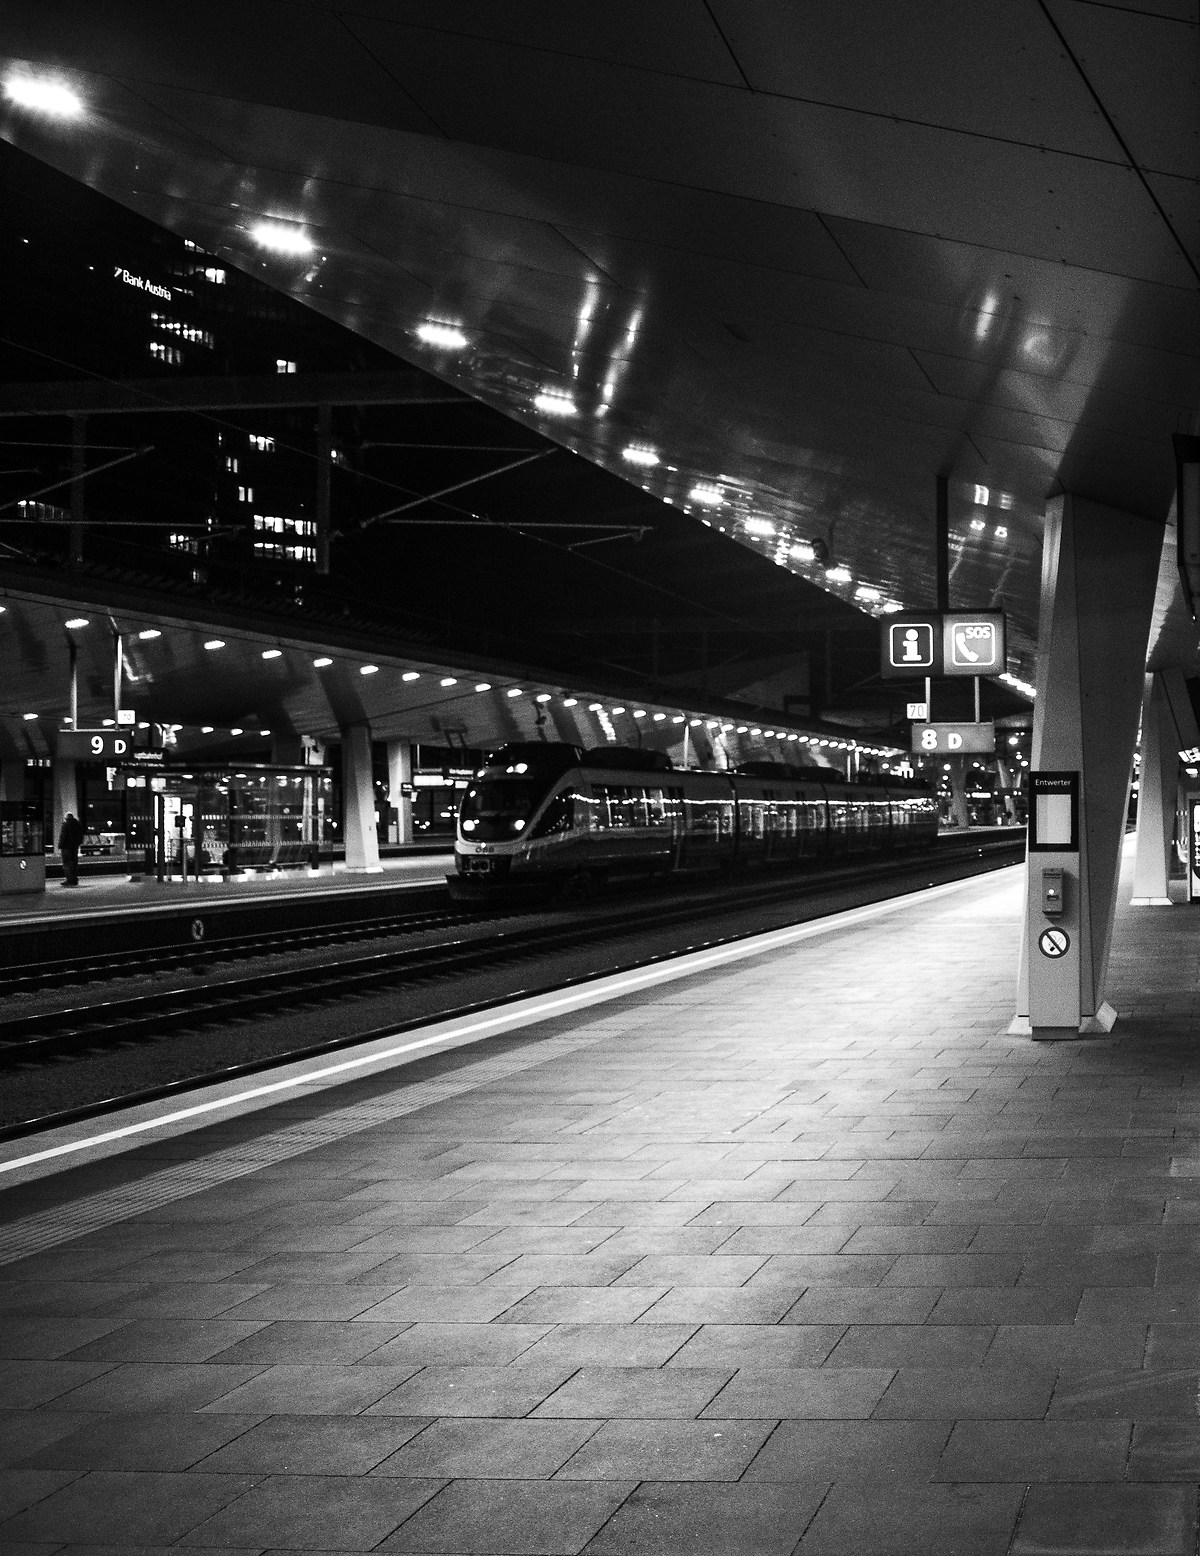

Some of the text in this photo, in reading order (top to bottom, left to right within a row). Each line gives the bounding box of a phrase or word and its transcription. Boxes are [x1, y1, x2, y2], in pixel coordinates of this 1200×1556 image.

[122, 269, 172, 301] Bank Austria
[965, 626, 991, 639] SOS
[910, 705, 924, 717] 70
[91, 735, 127, 755] 9 D
[921, 729, 963, 750] 8 D
[1035, 779, 1072, 787] Entwerter
